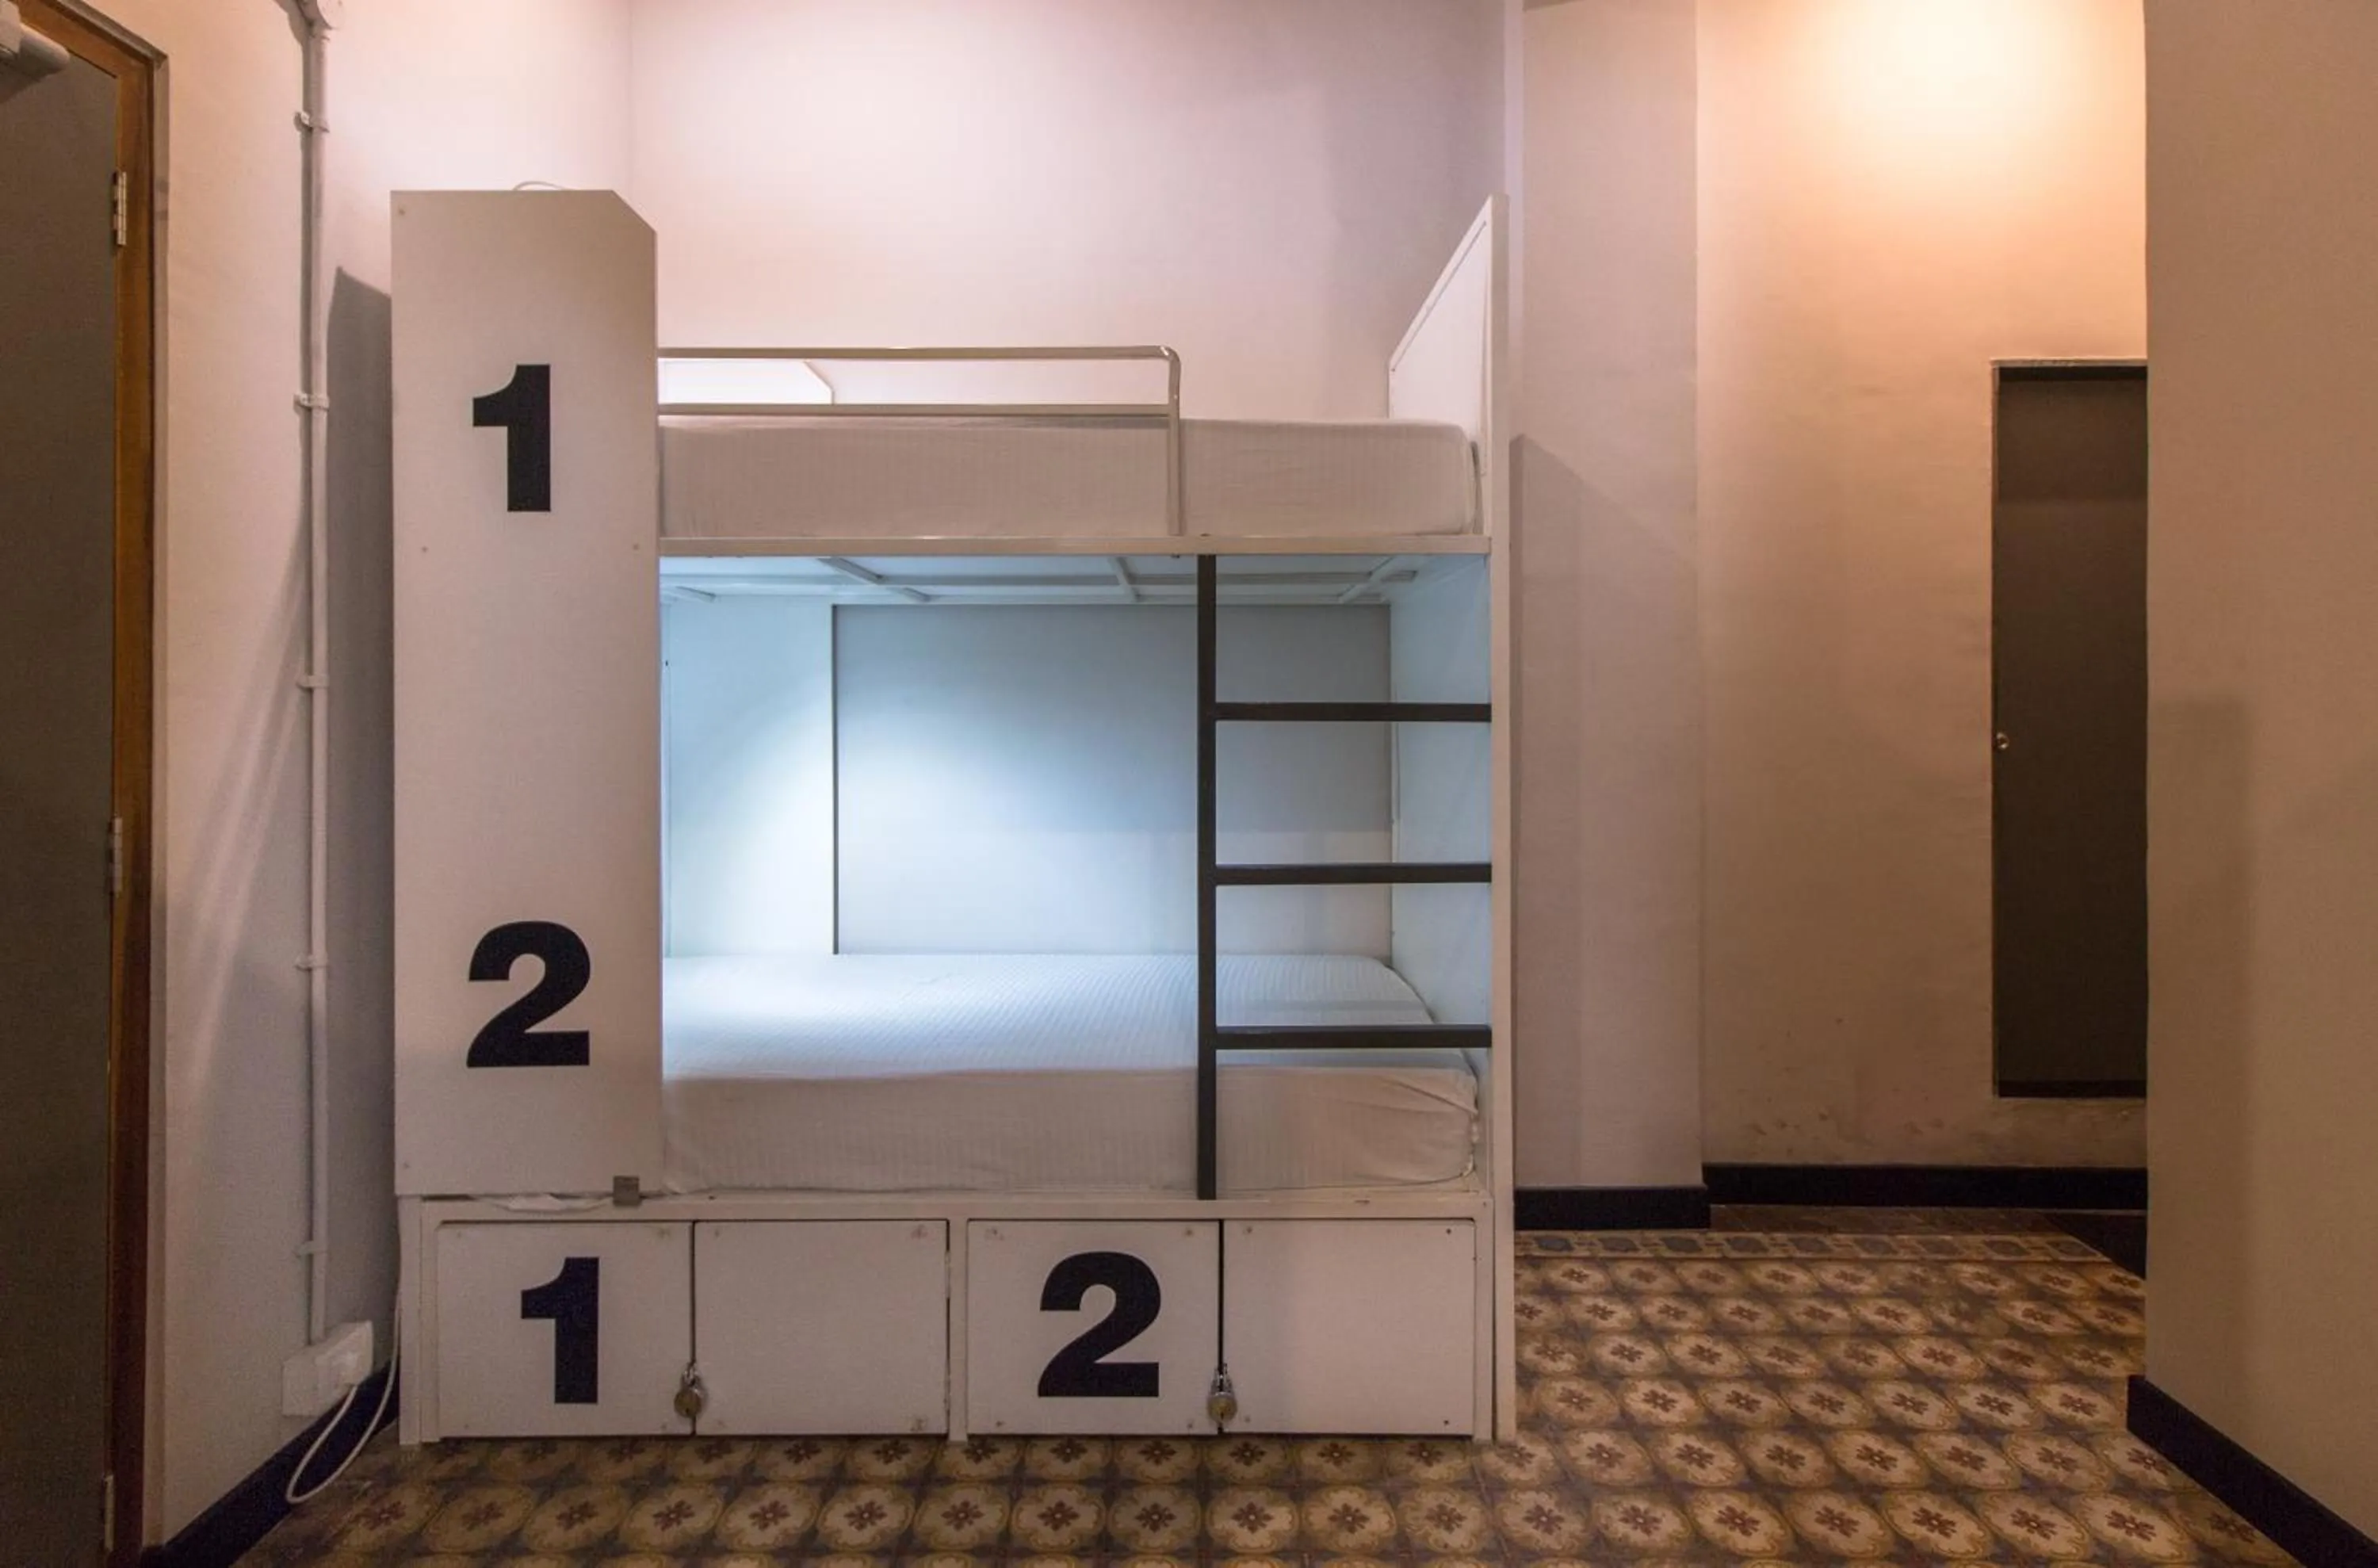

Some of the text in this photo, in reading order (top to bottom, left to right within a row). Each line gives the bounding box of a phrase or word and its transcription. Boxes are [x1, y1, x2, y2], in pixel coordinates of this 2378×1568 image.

[472, 365, 551, 512] 1
[466, 920, 591, 1069] 2
[520, 1256, 600, 1405] 1
[1038, 1251, 1161, 1398] 2
